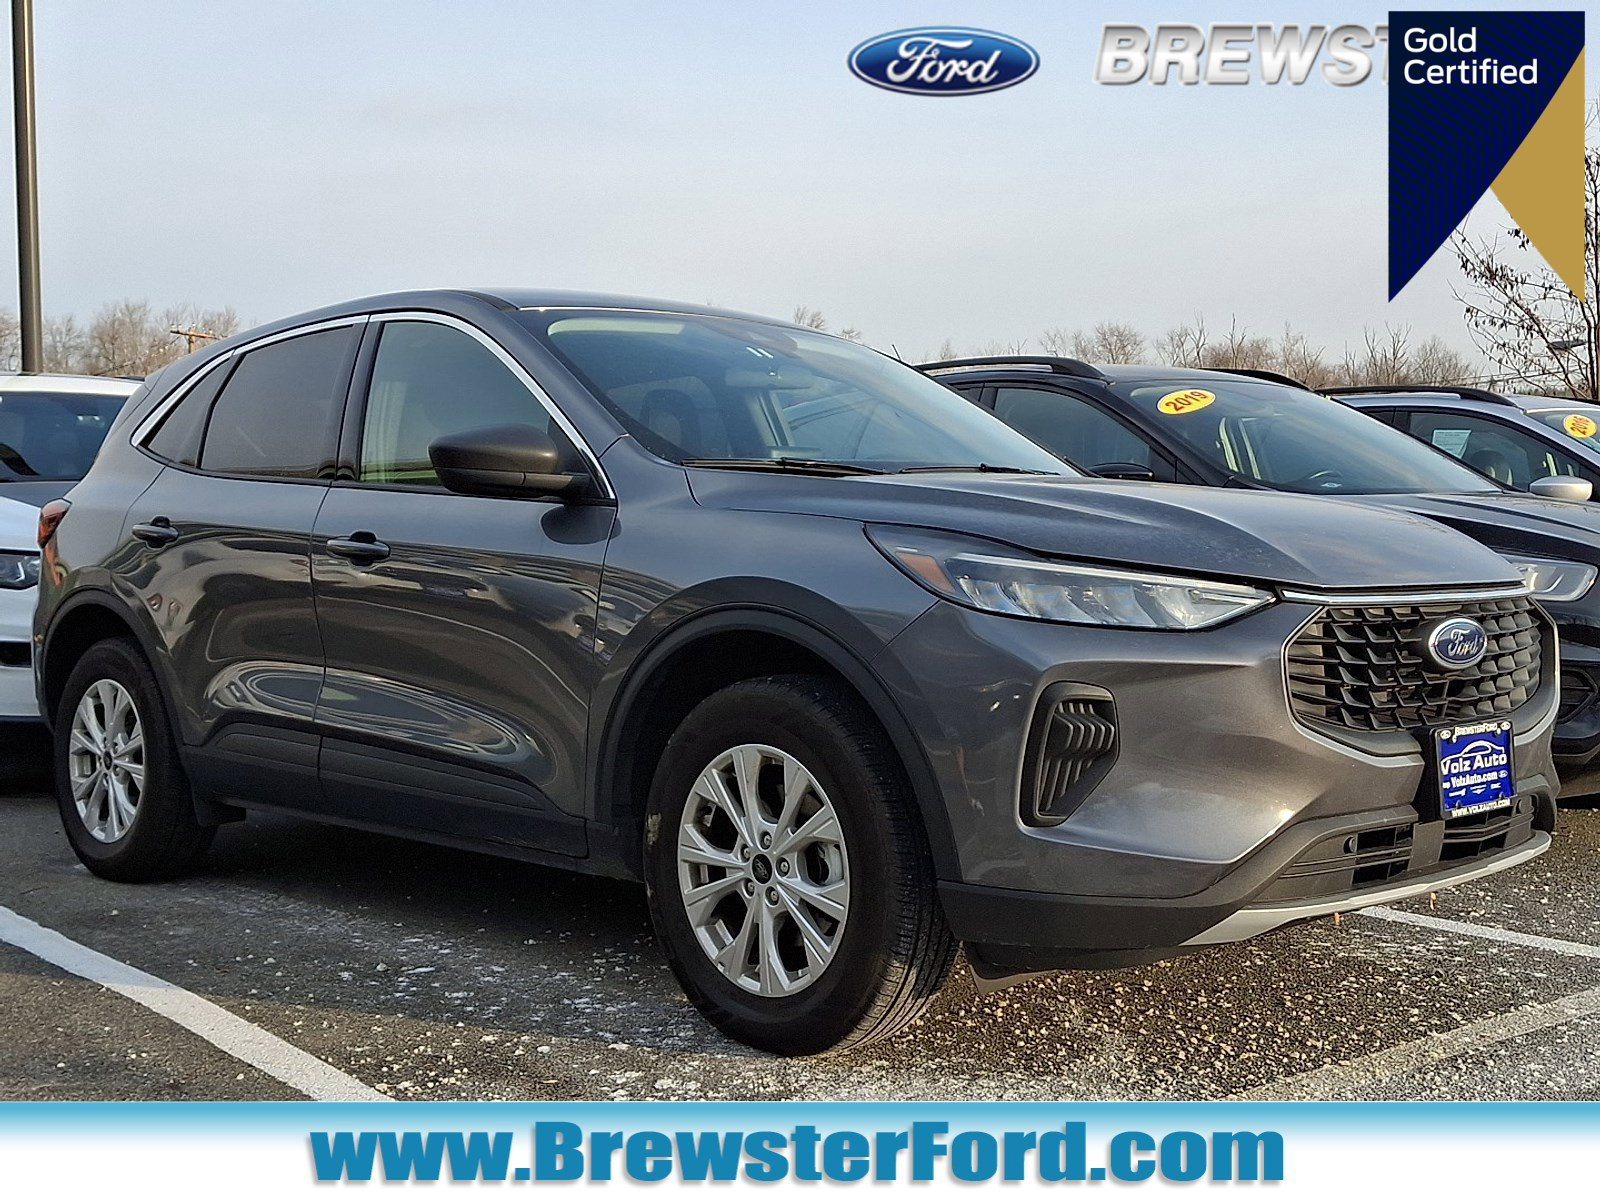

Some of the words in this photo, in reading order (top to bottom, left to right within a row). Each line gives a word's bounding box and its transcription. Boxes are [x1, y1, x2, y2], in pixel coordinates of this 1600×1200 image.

[1165, 391, 1207, 411] 2019
[1447, 628, 1479, 657] Ford
[1440, 757, 1471, 775] Volz
[1473, 753, 1508, 770] Auto
[1450, 771, 1498, 788] VolzAuto.com
